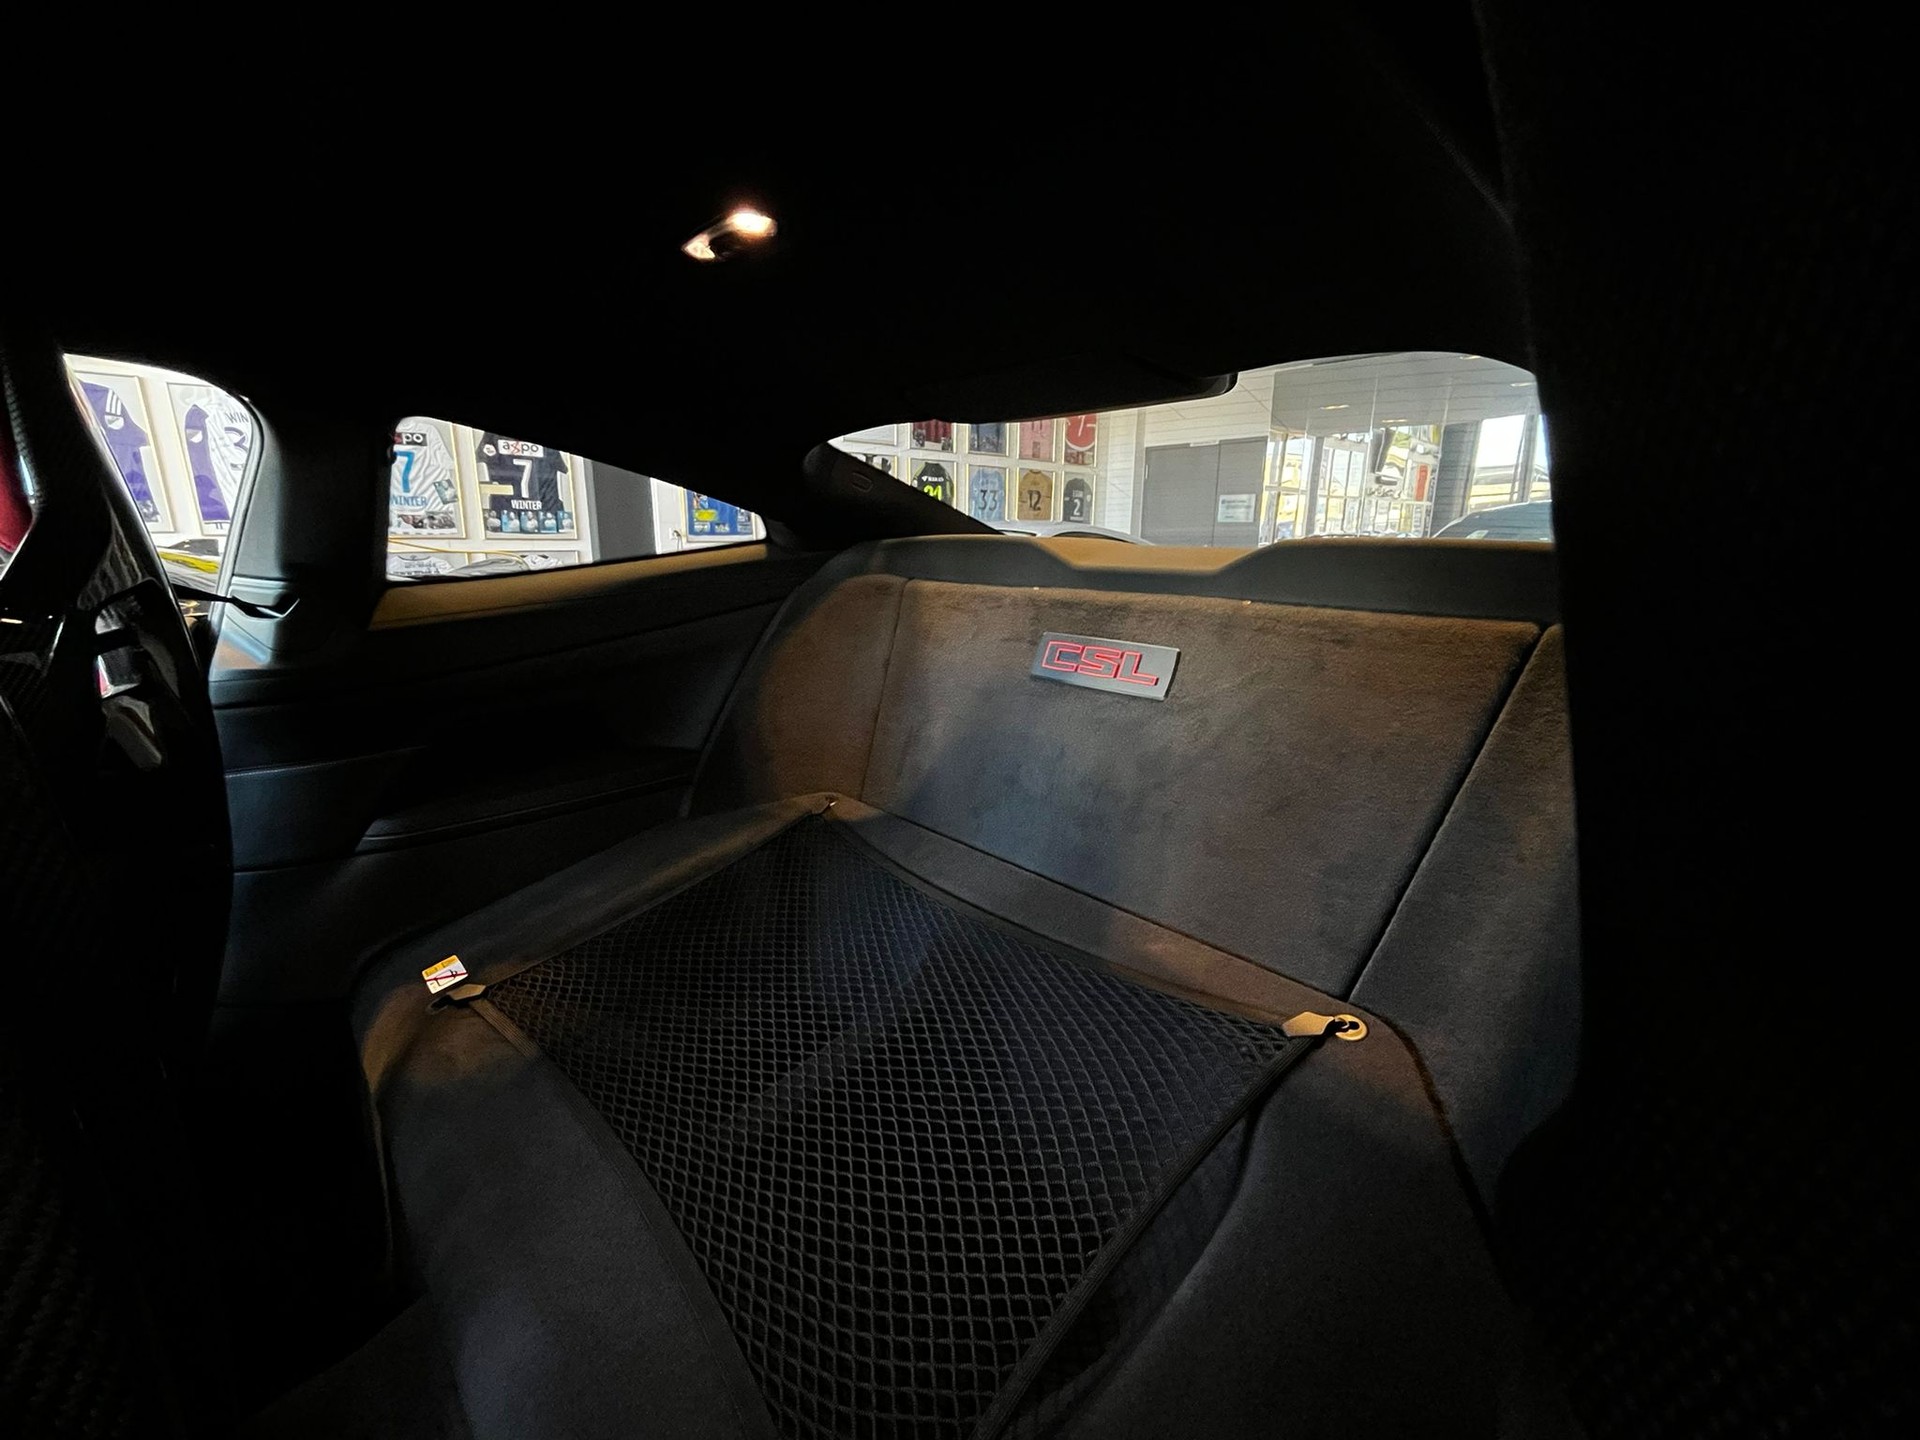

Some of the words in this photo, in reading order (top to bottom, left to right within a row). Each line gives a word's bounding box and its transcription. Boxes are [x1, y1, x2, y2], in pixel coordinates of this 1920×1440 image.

[395, 432, 424, 445] po
[394, 450, 415, 494] 7
[512, 458, 533, 498] 7
[511, 499, 542, 510] WINTER
[979, 489, 1000, 511] 33
[1027, 489, 1041, 511] 12
[1073, 498, 1081, 516] 2
[1042, 640, 1160, 686] CSL
